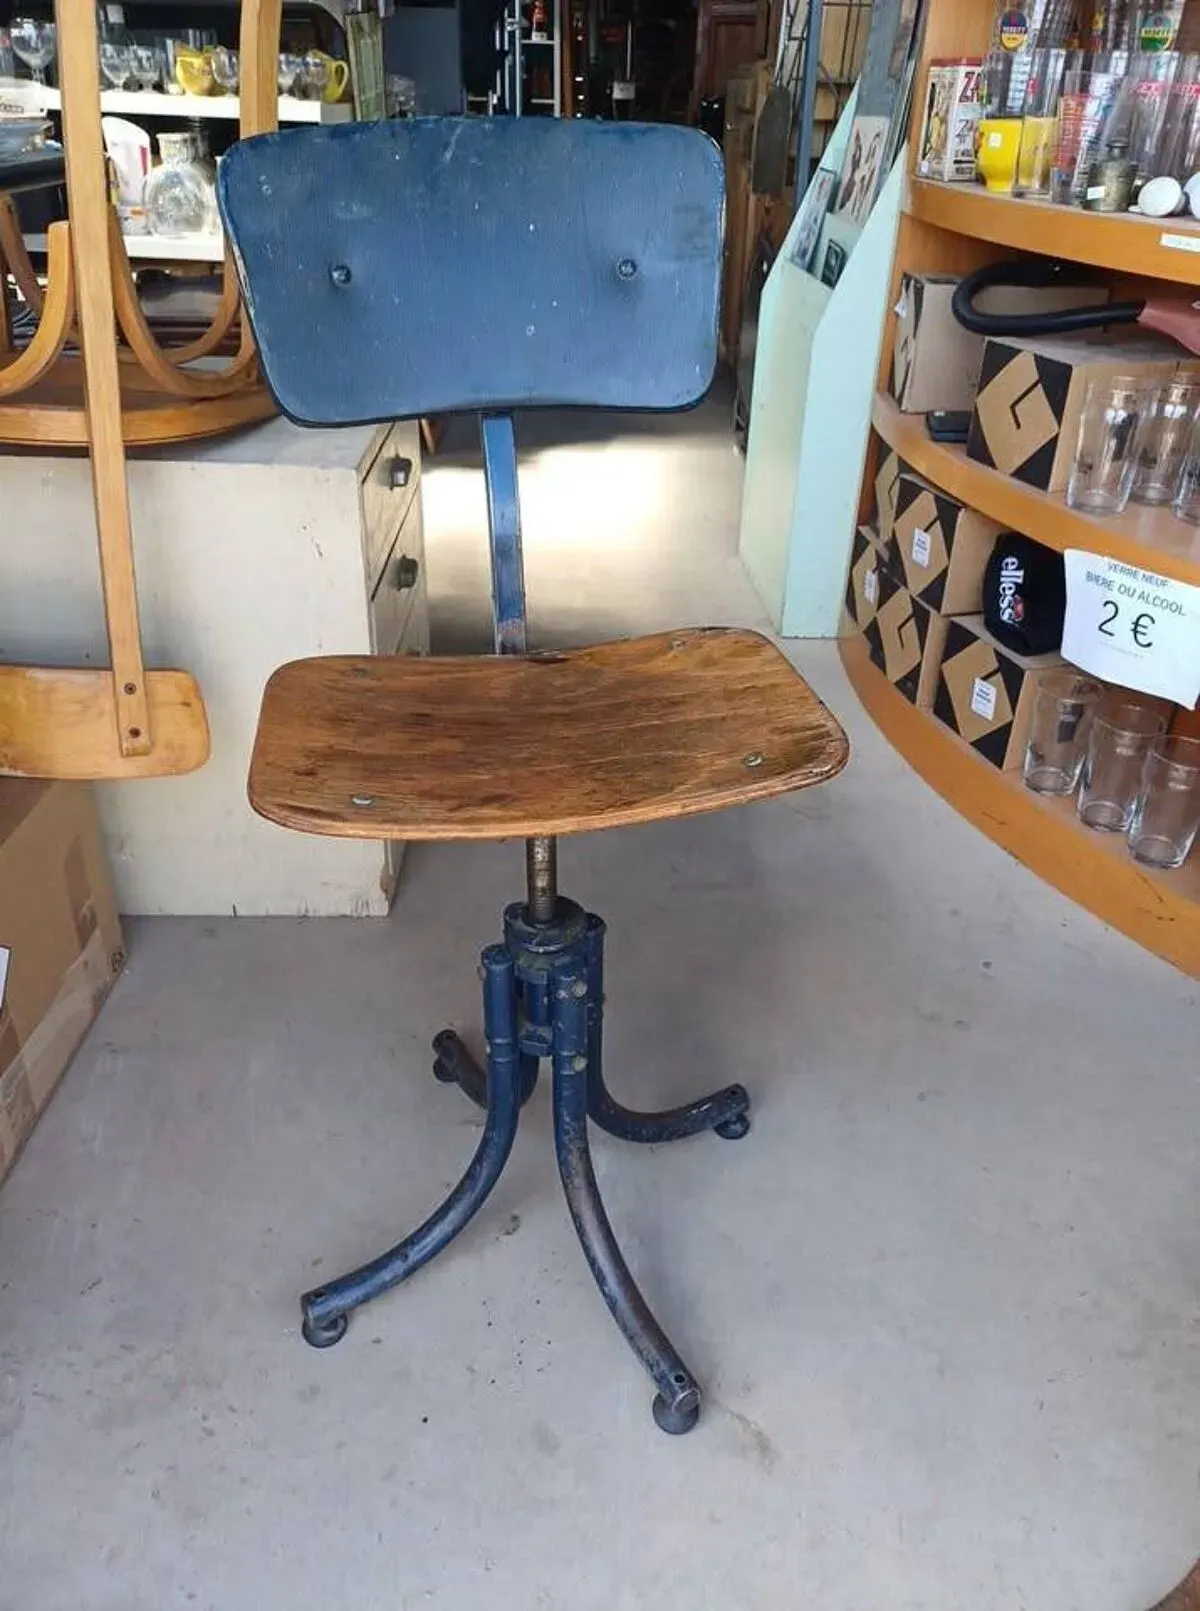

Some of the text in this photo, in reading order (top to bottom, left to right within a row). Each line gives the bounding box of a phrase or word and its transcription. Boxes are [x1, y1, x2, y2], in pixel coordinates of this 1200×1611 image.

[999, 556, 1024, 625] elless
[1108, 563, 1170, 587] VERRE NEUF
[1117, 584, 1136, 598] OU
[1138, 590, 1187, 616] ALCOOL
[1097, 600, 1155, 648] 2 €
